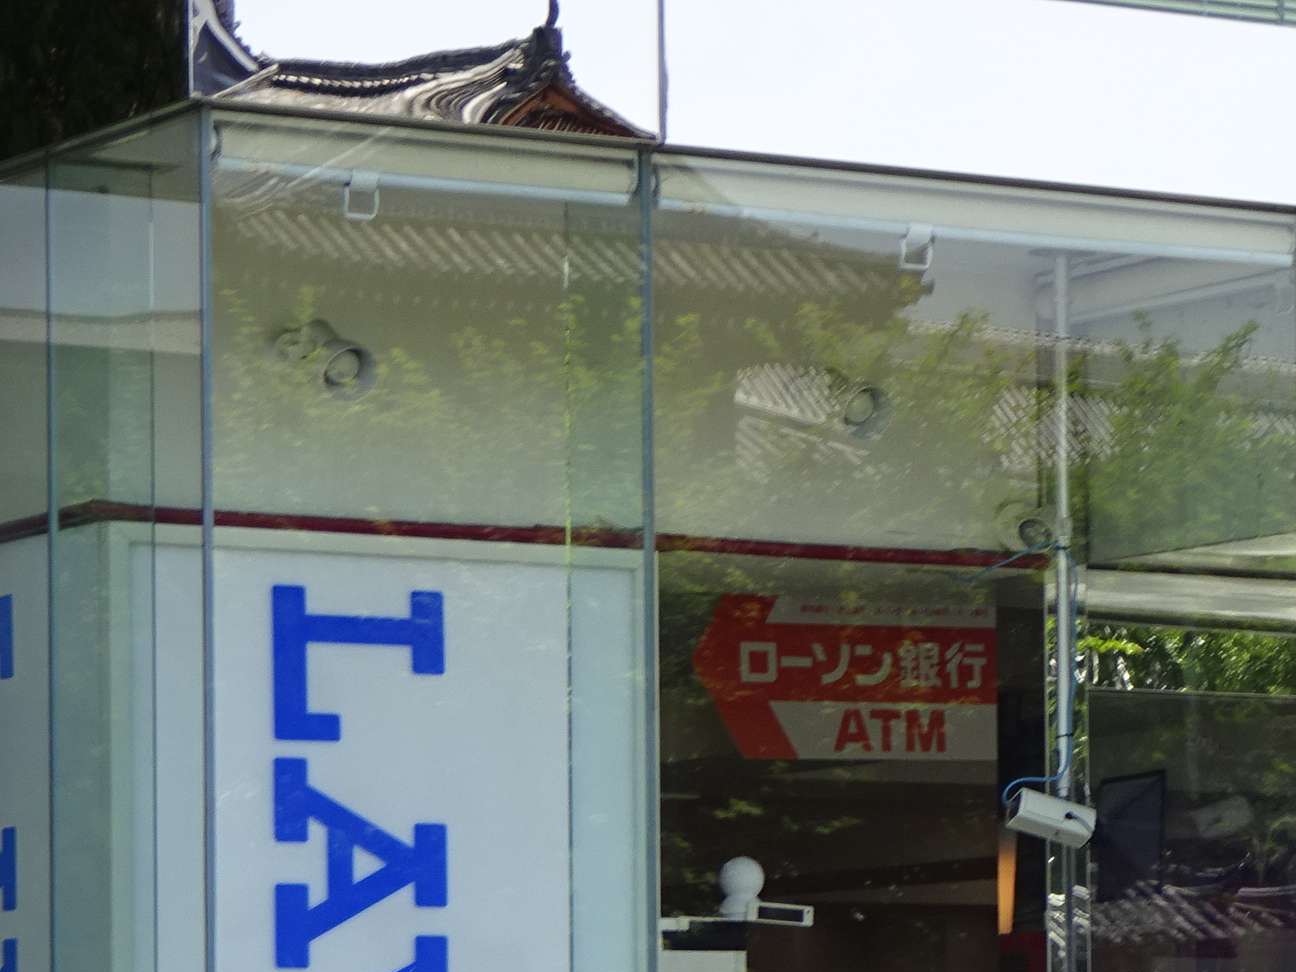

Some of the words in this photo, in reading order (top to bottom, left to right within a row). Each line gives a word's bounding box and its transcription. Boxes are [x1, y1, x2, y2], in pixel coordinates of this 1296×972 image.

[738, 640, 988, 690] ローソン銀行
[832, 708, 948, 753] ATM
